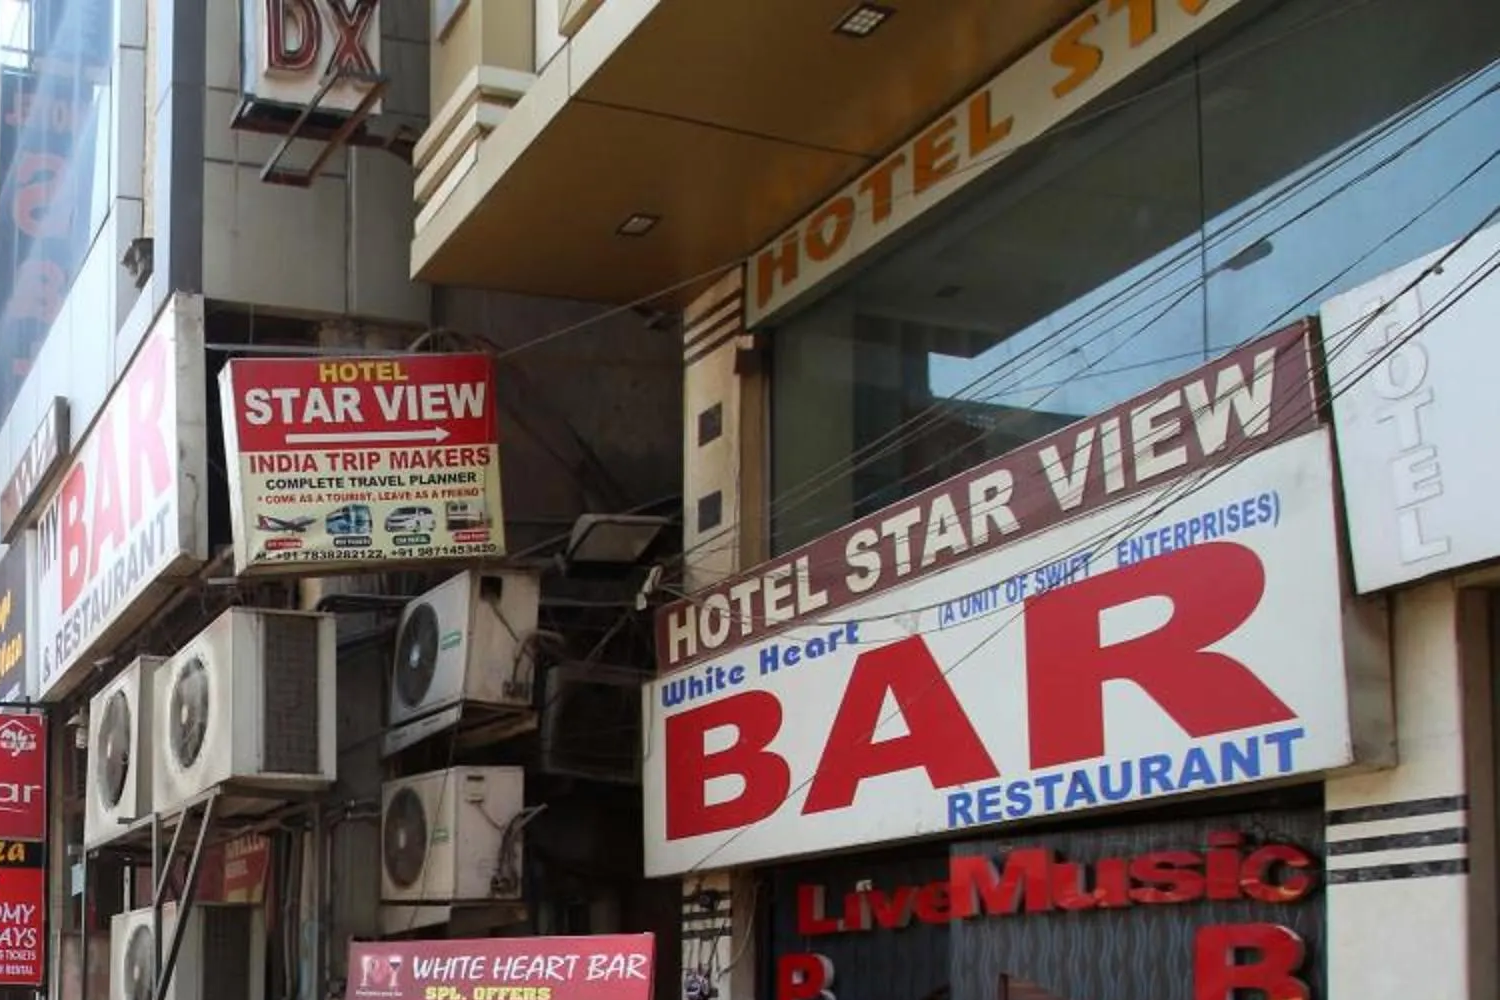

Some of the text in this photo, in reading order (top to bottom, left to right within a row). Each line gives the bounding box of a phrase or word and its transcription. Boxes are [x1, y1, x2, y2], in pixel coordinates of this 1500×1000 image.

[756, 0, 1218, 309] HOTEL ST
[245, 381, 486, 426] STAR VIEW
[319, 361, 408, 383] HOTEL
[61, 333, 172, 616] BAR
[250, 447, 490, 474] INDIA TRIP MAKERS
[266, 471, 477, 491] COMPLETE TRAVEL PLANNER
[668, 345, 1281, 664] HOTEL STAR VIEW
[55, 503, 172, 671] RESTAURANT
[958, 587, 1001, 627] UNIT
[1006, 578, 1031, 610] OF
[1034, 550, 1095, 601] SWIFT
[1116, 490, 1282, 571] ENTERPRISES)
[661, 619, 860, 708] White Heart
[664, 538, 1301, 842] BAR
[946, 727, 1306, 829] RESTAURANT
[795, 830, 1319, 937] Live Music
[413, 953, 648, 982] WHITE HEART BAR
[425, 987, 468, 1000] SPL.
